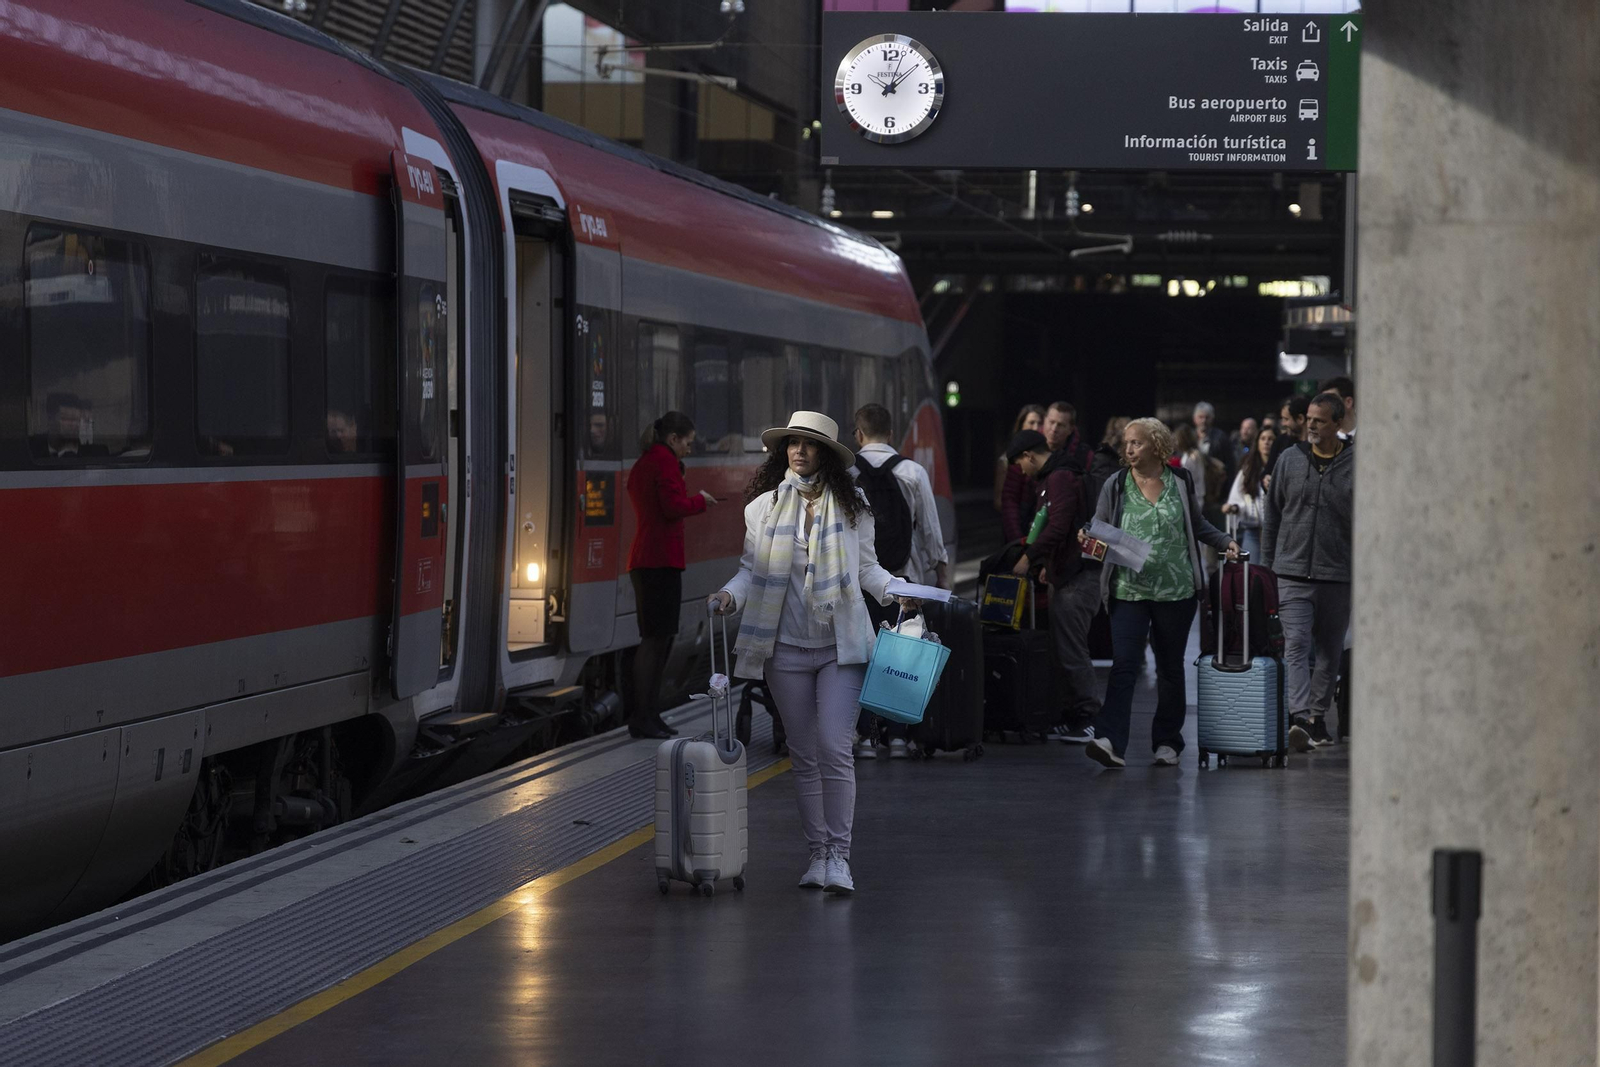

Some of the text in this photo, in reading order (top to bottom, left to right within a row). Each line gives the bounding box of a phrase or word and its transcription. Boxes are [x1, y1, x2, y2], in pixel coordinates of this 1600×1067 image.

[1243, 18, 1289, 32] Salida
[1269, 36, 1288, 44] EXIT
[881, 50, 900, 61] 12
[1250, 56, 1288, 70] Taxis
[1264, 75, 1288, 84] TAXIS
[850, 83, 862, 94] 9
[918, 83, 929, 94] 3
[1168, 96, 1287, 112] Bus aeropuerto
[884, 116, 896, 128] 6
[1229, 114, 1287, 123] AIRPORT BUS
[1124, 134, 1286, 149] Información turística
[1188, 152, 1286, 162] TOURIST INFORMATION
[882, 665, 919, 682] Aromas
